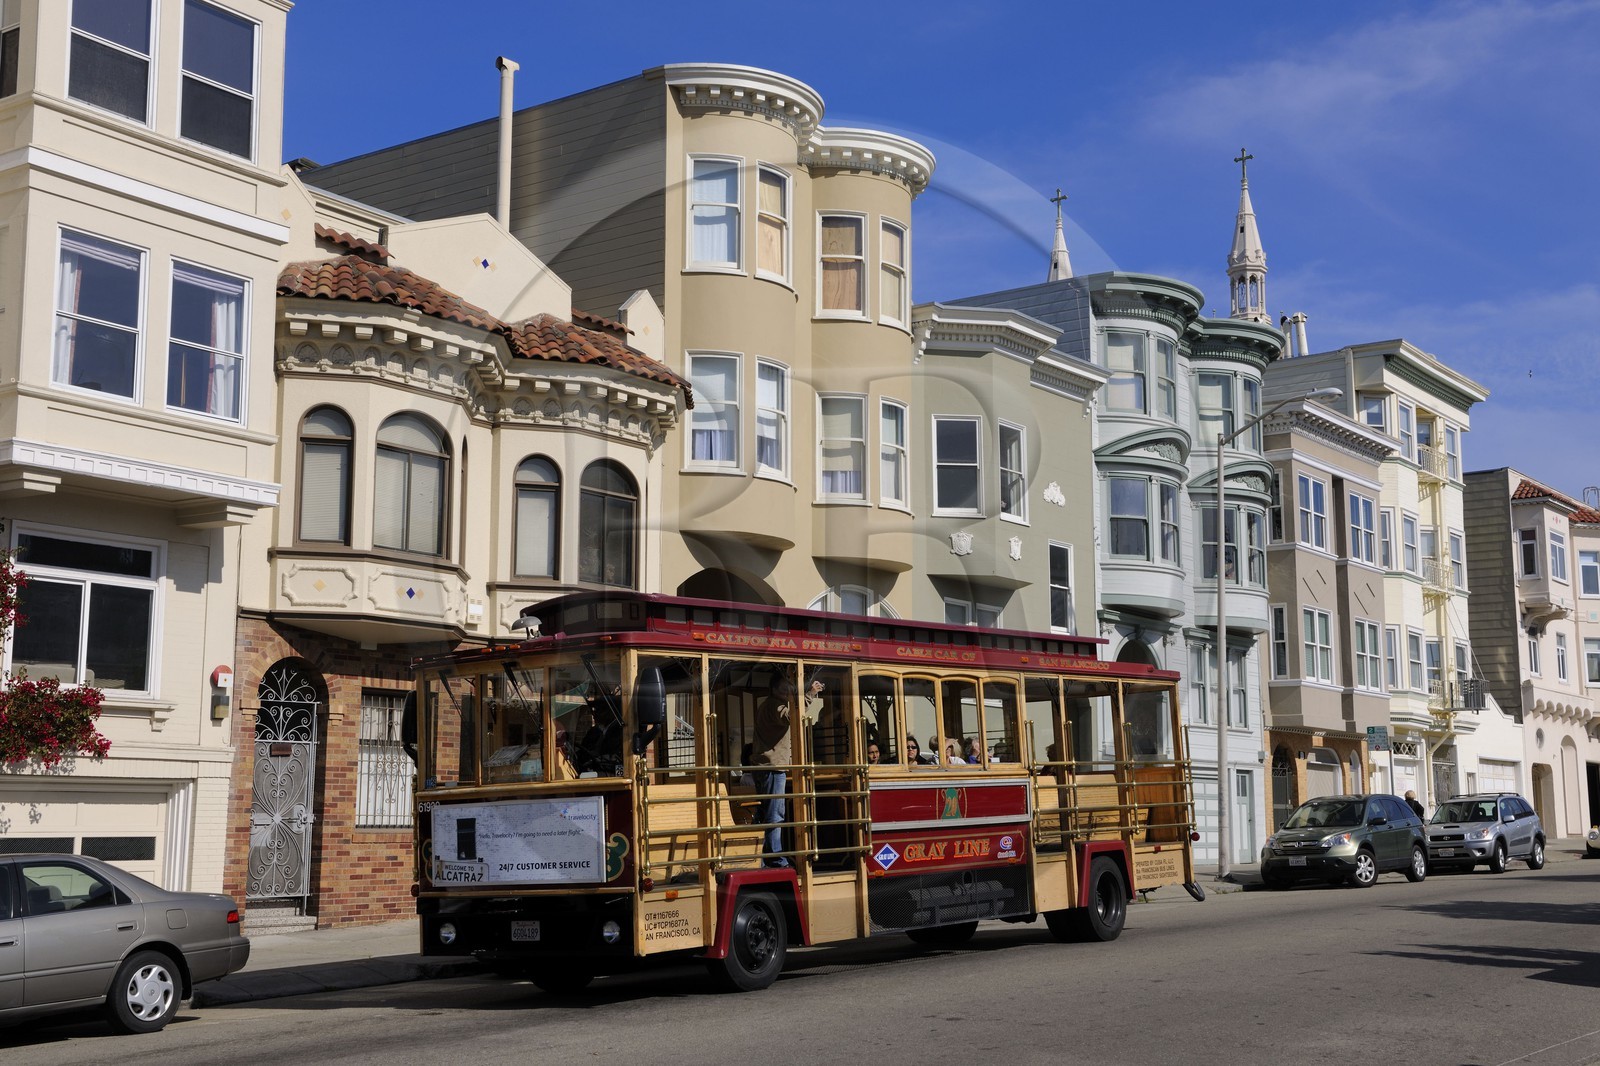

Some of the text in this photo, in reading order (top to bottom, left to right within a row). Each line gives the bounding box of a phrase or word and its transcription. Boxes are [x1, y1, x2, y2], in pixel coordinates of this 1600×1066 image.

[706, 633, 797, 649] CALIFORNIA
[802, 639, 850, 653] STREET
[897, 647, 933, 658] CABLE
[935, 649, 958, 660] CAR
[1039, 656, 1058, 667] SAN
[1060, 658, 1109, 670] FRANCISCO
[904, 838, 990, 862] GRAY LINE
[445, 864, 466, 872] WELCOME
[499, 861, 591, 872] 24/7 CUSTOMER SERVICE
[645, 910, 679, 921] OT#1167666
[656, 928, 691, 939] FRANCISCO,
[692, 927, 701, 935] CA
